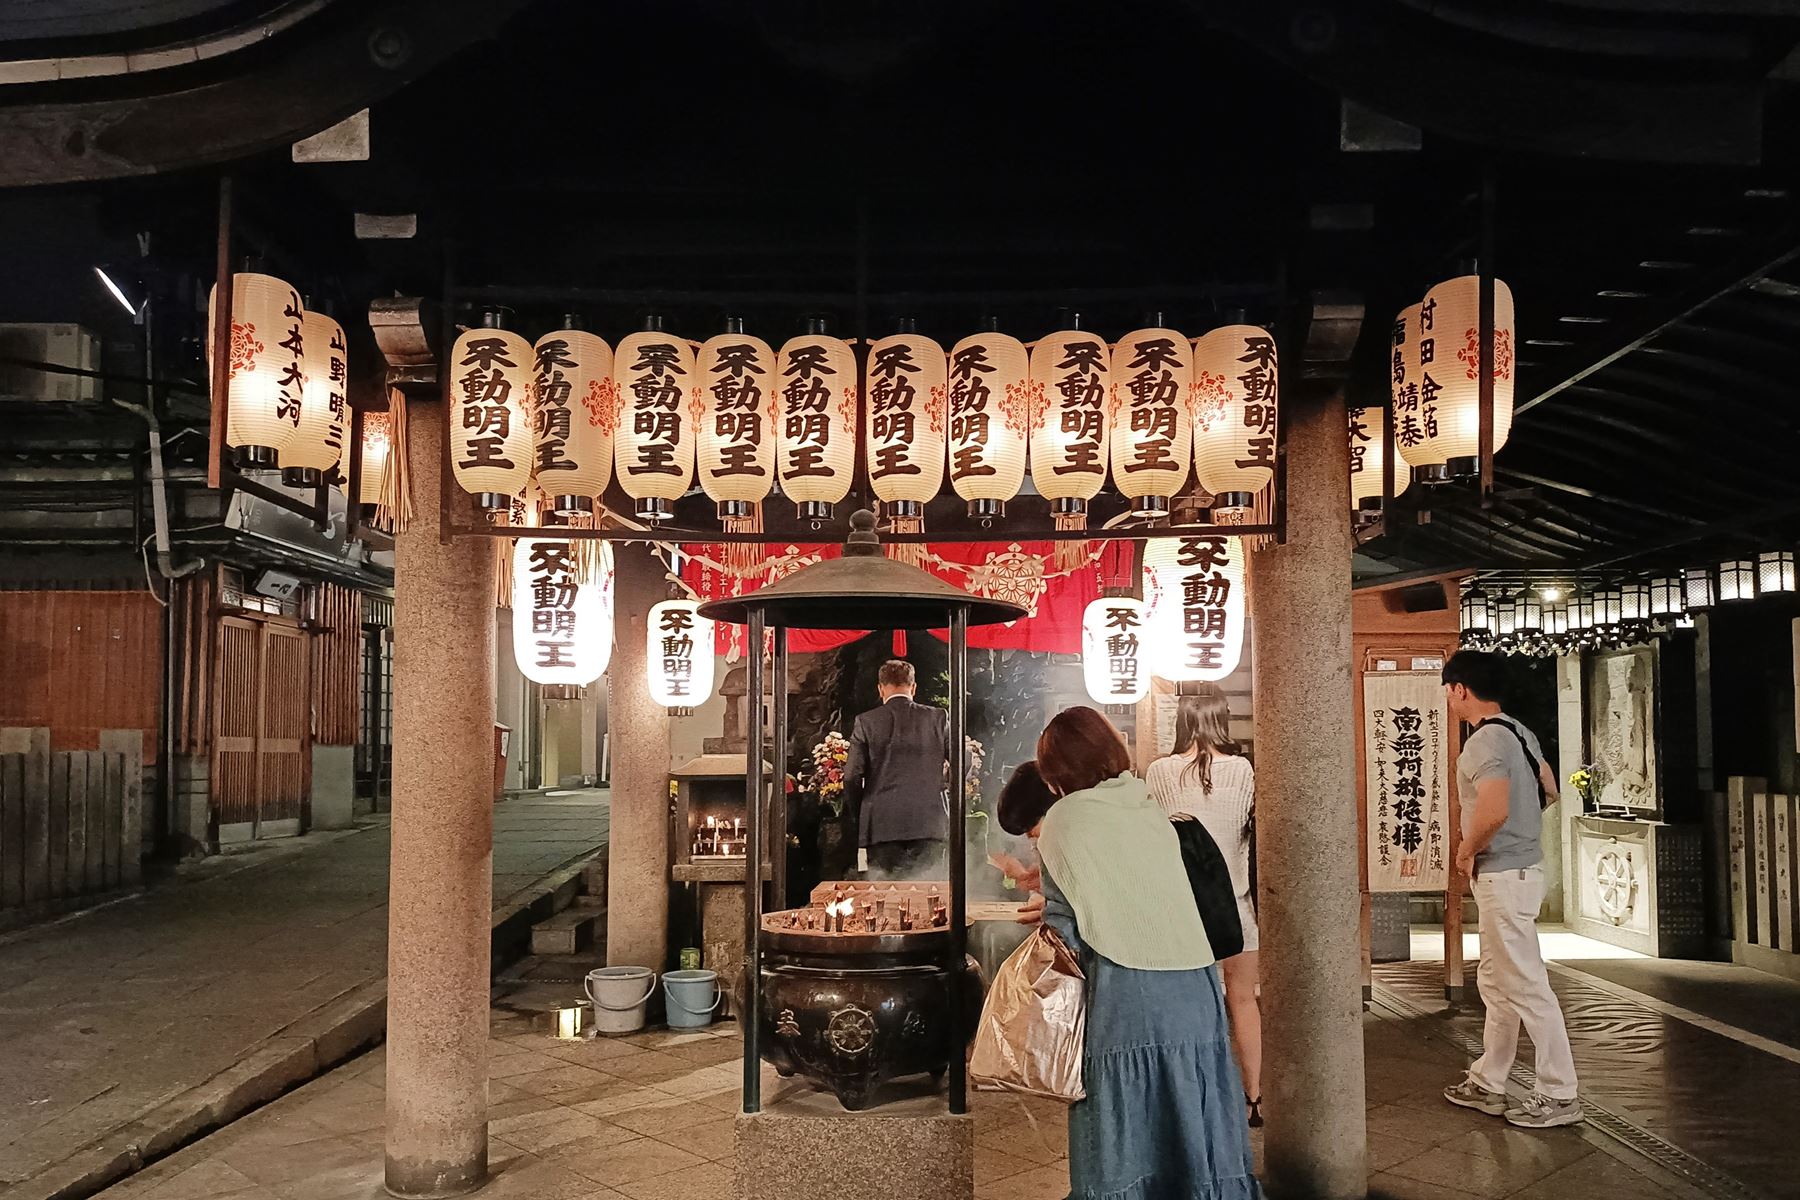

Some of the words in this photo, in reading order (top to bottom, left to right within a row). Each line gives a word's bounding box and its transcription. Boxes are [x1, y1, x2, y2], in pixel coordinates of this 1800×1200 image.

[459, 337, 517, 470] 不動明王
[533, 339, 579, 471] 不動明王
[628, 343, 687, 476] 不動明王
[710, 345, 766, 477] 不動明王
[782, 345, 836, 480] 不動明王
[870, 343, 922, 480] 不動明王
[950, 344, 997, 481] 不動明王
[1053, 341, 1107, 476] 不動明王
[1124, 338, 1183, 471] 不動明王
[1235, 337, 1277, 469] 不動明王
[529, 542, 578, 667] 不動明王
[660, 609, 694, 696] 不動明王
[1105, 608, 1141, 694] 不動明王
[1177, 536, 1230, 669] 不動明王
